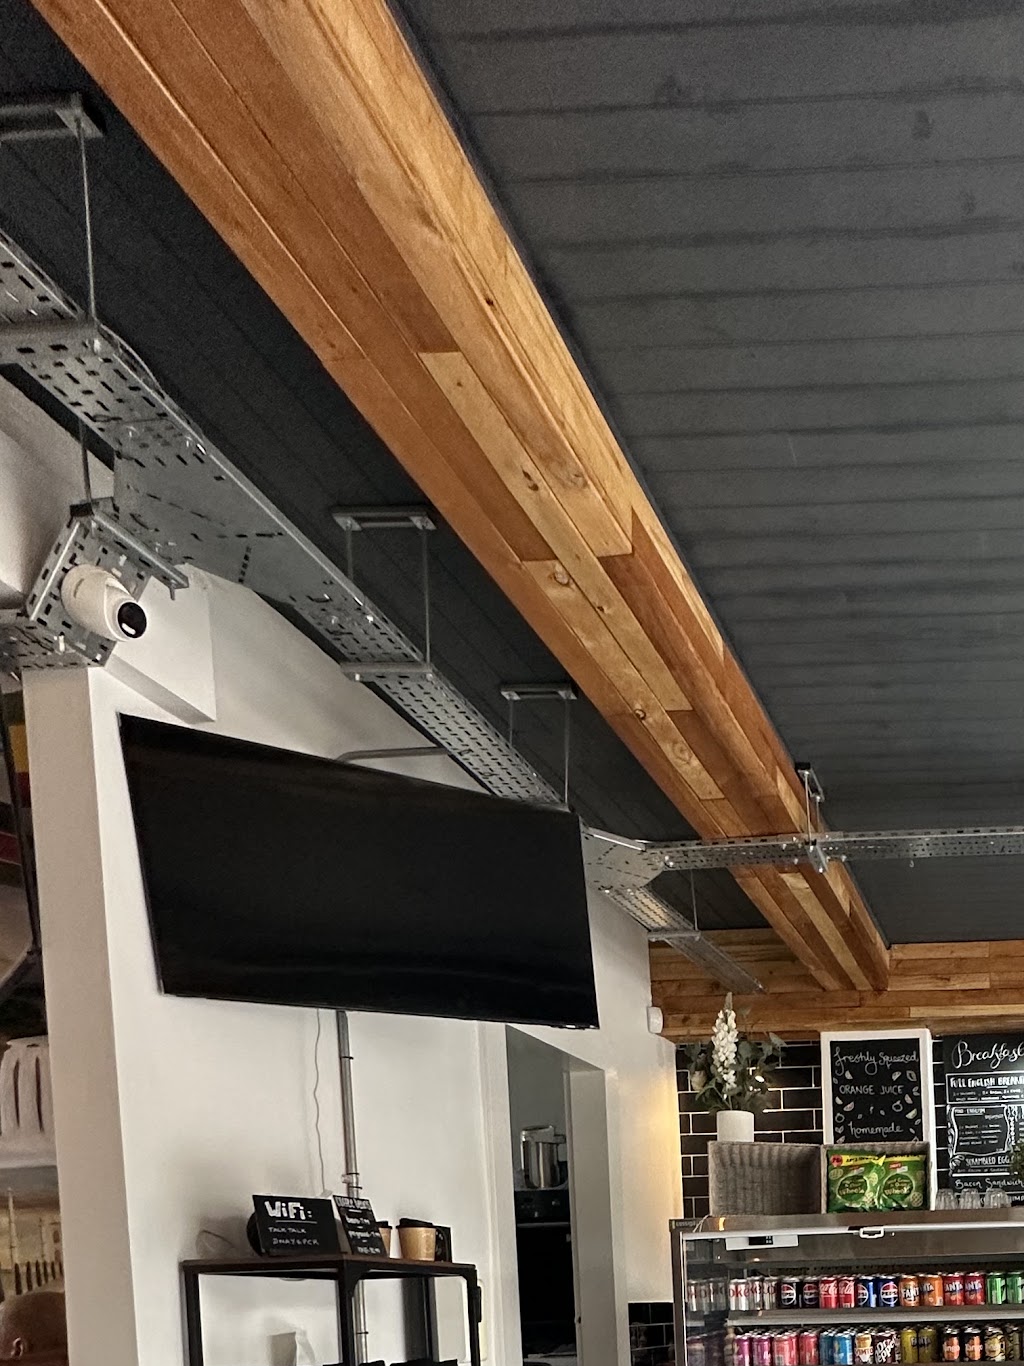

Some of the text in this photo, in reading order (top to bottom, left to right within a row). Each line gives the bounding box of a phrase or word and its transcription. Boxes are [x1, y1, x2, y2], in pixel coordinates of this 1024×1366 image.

[950, 1077, 966, 1088] FULL
[839, 1085, 904, 1095] ORANGE JUICE
[849, 1122, 904, 1138] homemade
[955, 1180, 982, 1189] Bacon
